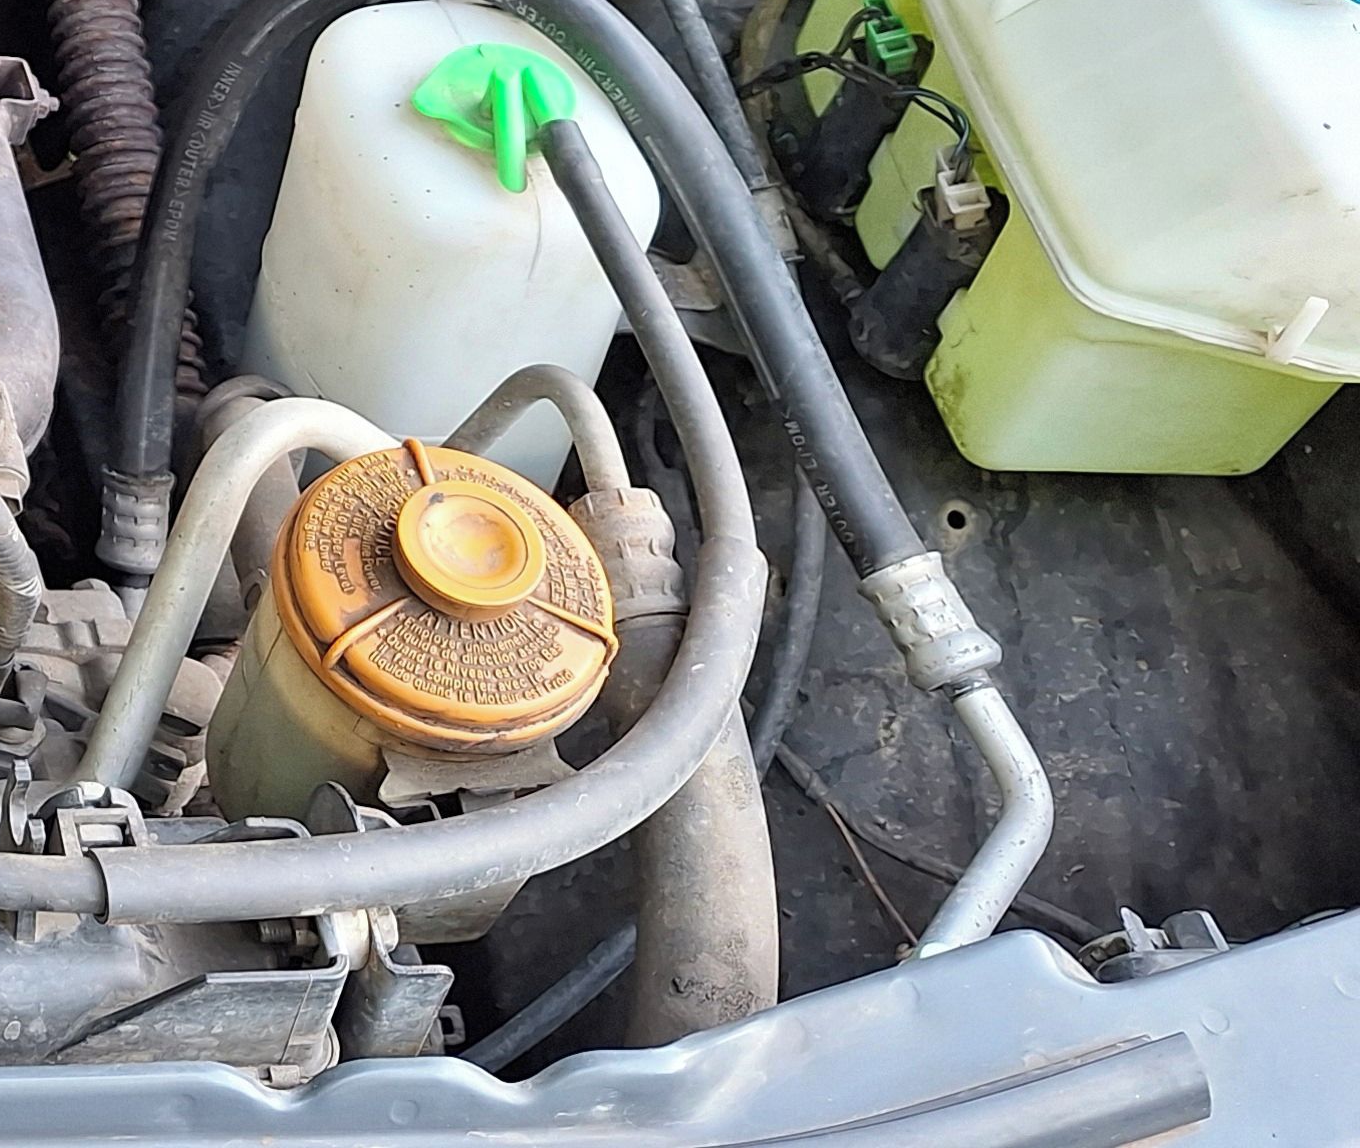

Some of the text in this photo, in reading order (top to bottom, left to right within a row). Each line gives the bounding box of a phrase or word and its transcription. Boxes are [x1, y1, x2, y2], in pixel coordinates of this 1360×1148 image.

[319, 539, 332, 573] Lower
[334, 561, 356, 593] Level
[418, 609, 527, 640] ATTENTION
[386, 633, 425, 664] Quand
[446, 662, 492, 680] Niveau
[495, 667, 515, 680] est
[542, 641, 565, 662] Bas
[462, 649, 517, 666] direction
[414, 677, 455, 700] quand
[476, 692, 520, 705] Moteur
